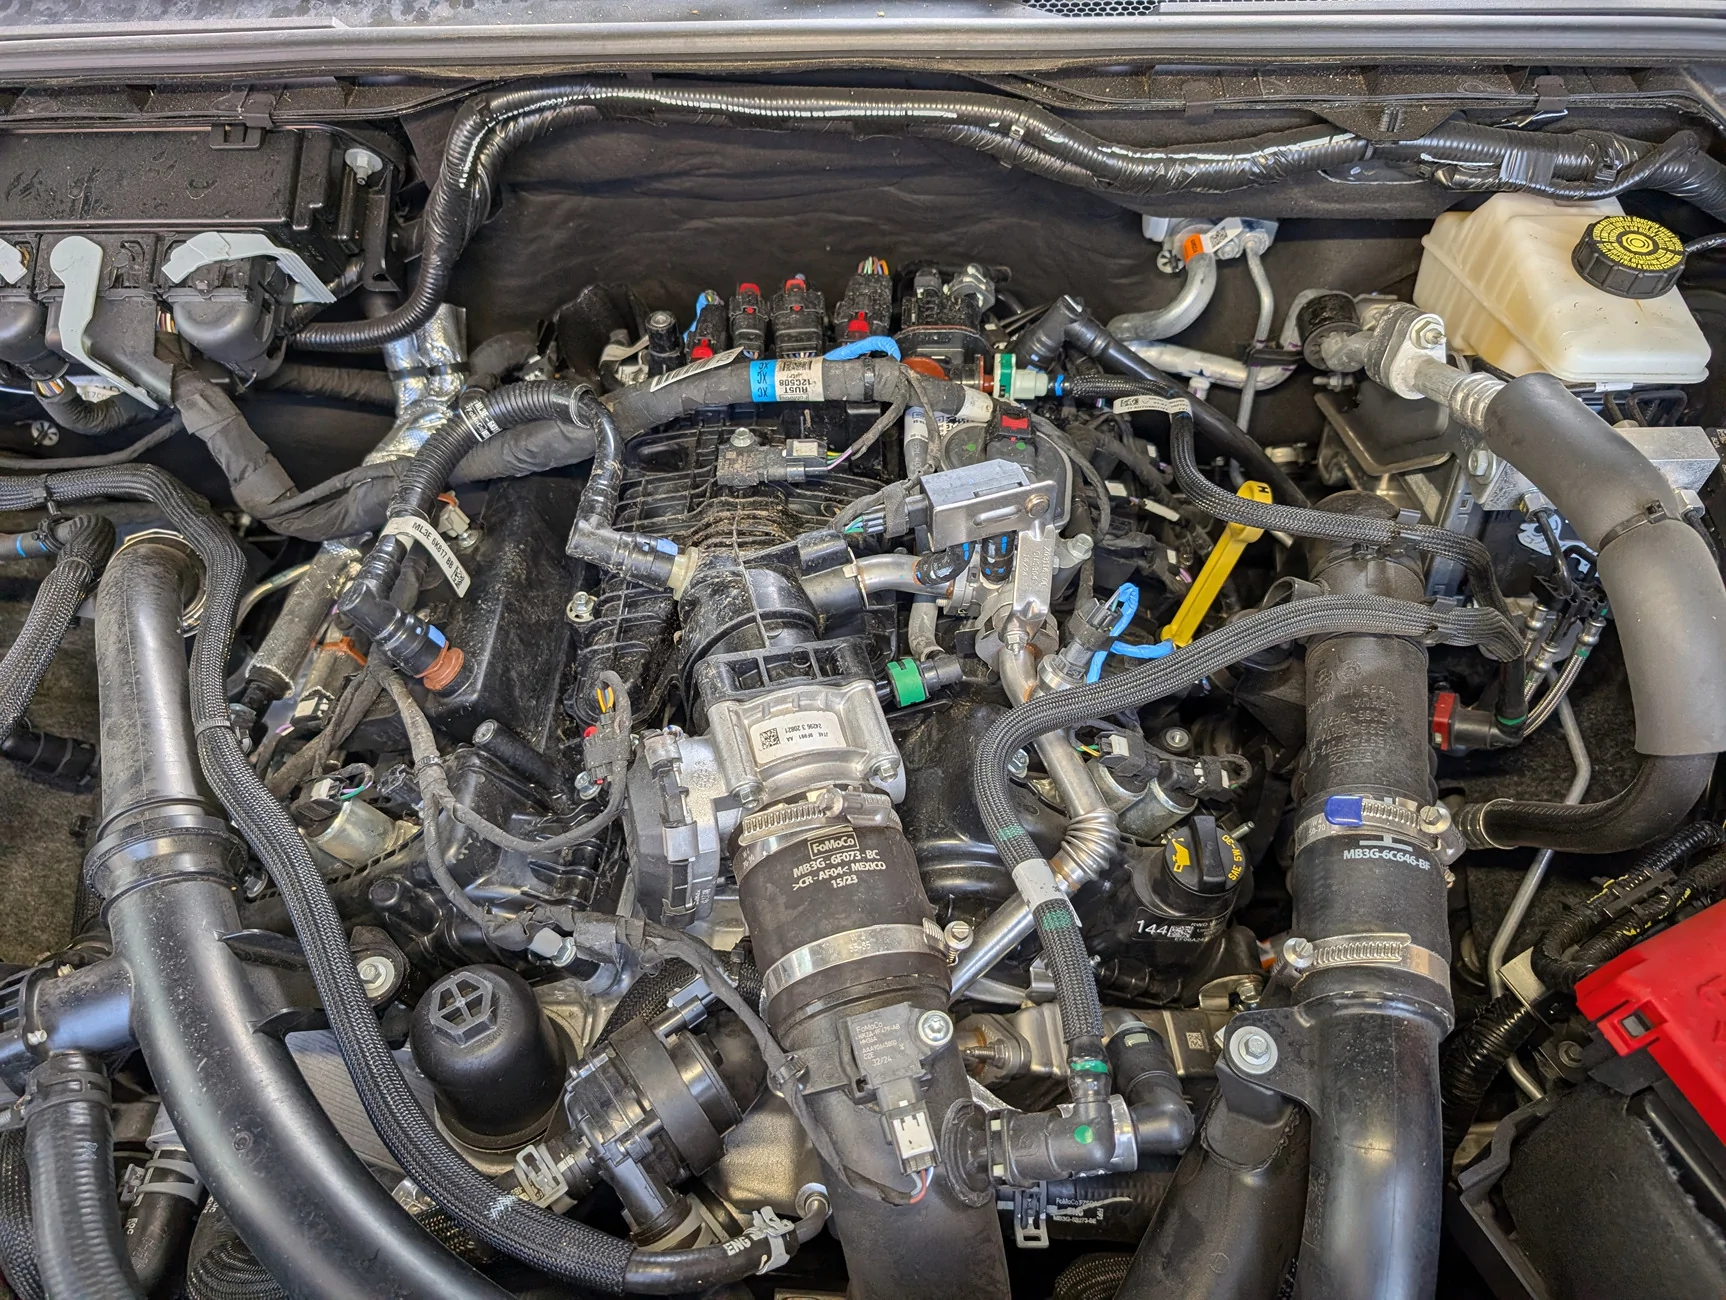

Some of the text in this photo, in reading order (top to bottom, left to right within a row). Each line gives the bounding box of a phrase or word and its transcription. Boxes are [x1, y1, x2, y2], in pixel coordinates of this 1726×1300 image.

[779, 378, 812, 387] 12C508
[411, 521, 433, 541] ML3E
[812, 836, 855, 854] FoMoCo
[792, 849, 881, 878] MB3G-6F073-BC
[850, 861, 887, 873] MEXICO
[1342, 848, 1431, 872] MB3G-6C646-BF
[1228, 864, 1242, 881] SAE
[830, 874, 859, 889] 15/23
[1137, 919, 1169, 936] 144
[856, 1021, 884, 1034] FoMoCo
[722, 1236, 752, 1257] ENG
